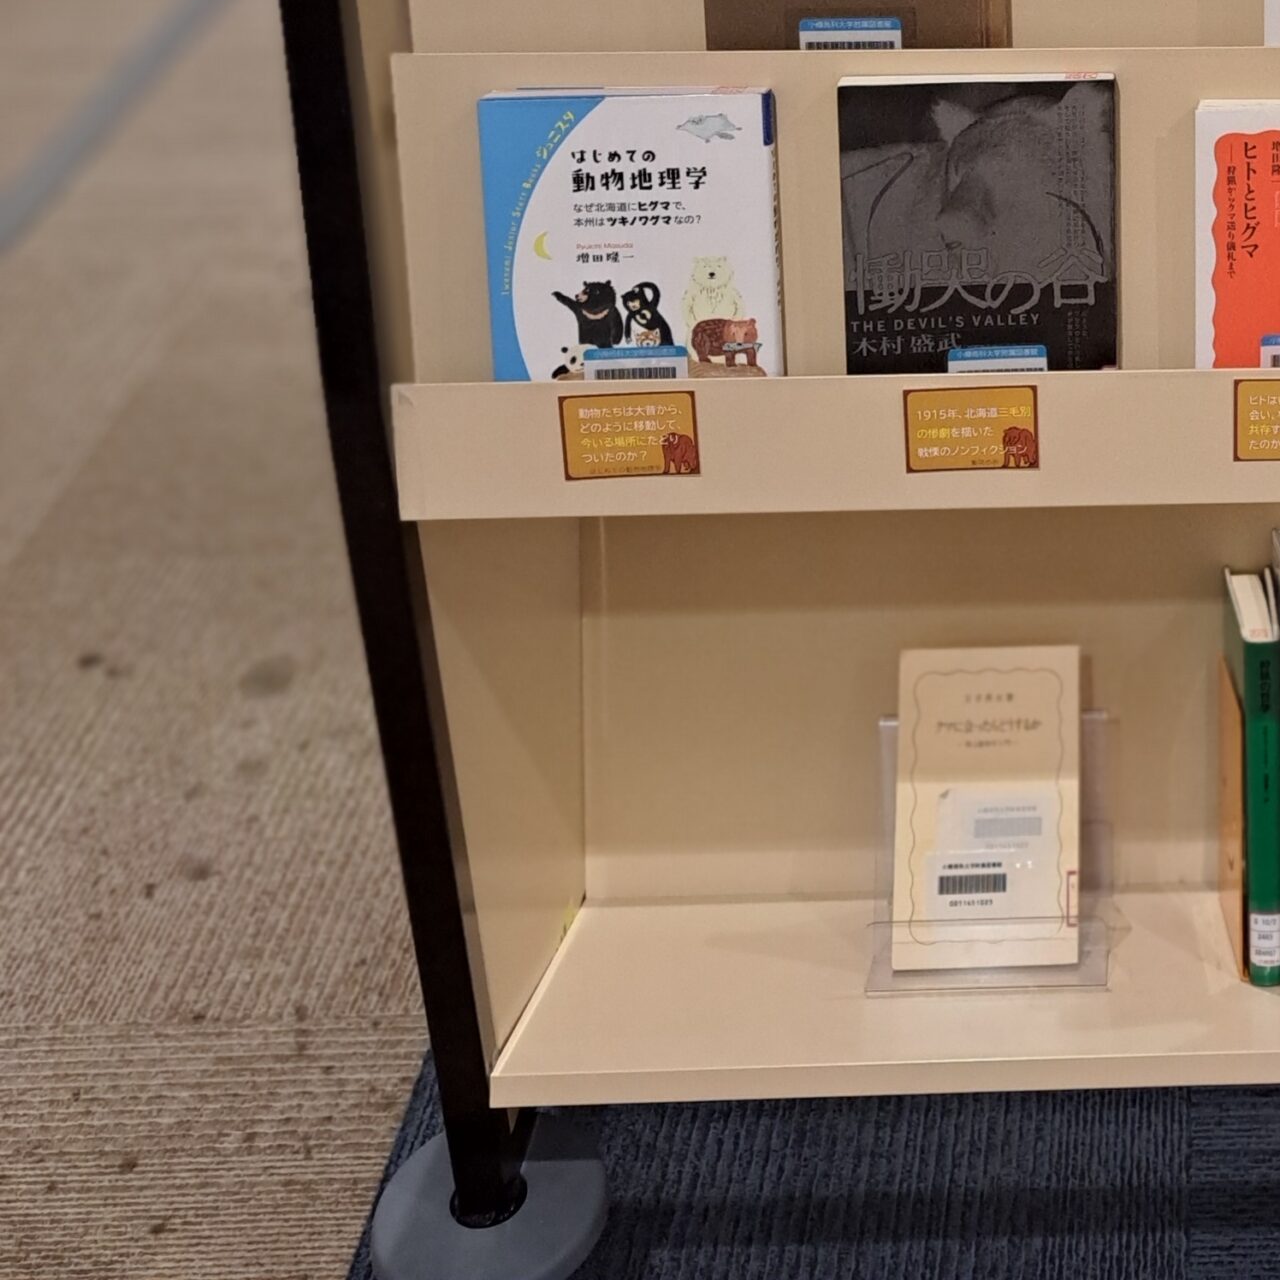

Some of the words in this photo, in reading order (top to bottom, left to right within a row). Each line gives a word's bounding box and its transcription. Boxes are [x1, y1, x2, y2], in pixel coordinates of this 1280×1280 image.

[571, 150, 656, 164] はじめての
[571, 167, 708, 193] 動物地理学
[573, 201, 686, 213] なぜ北海道にヒグマで、
[1241, 141, 1261, 259] ヒトとヒグマ
[850, 247, 1109, 315] 慟哭の谷
[851, 321, 886, 334] THE
[893, 316, 966, 331] DEVIL'S
[972, 313, 1041, 328] VALLEY
[852, 335, 905, 357] 木村
